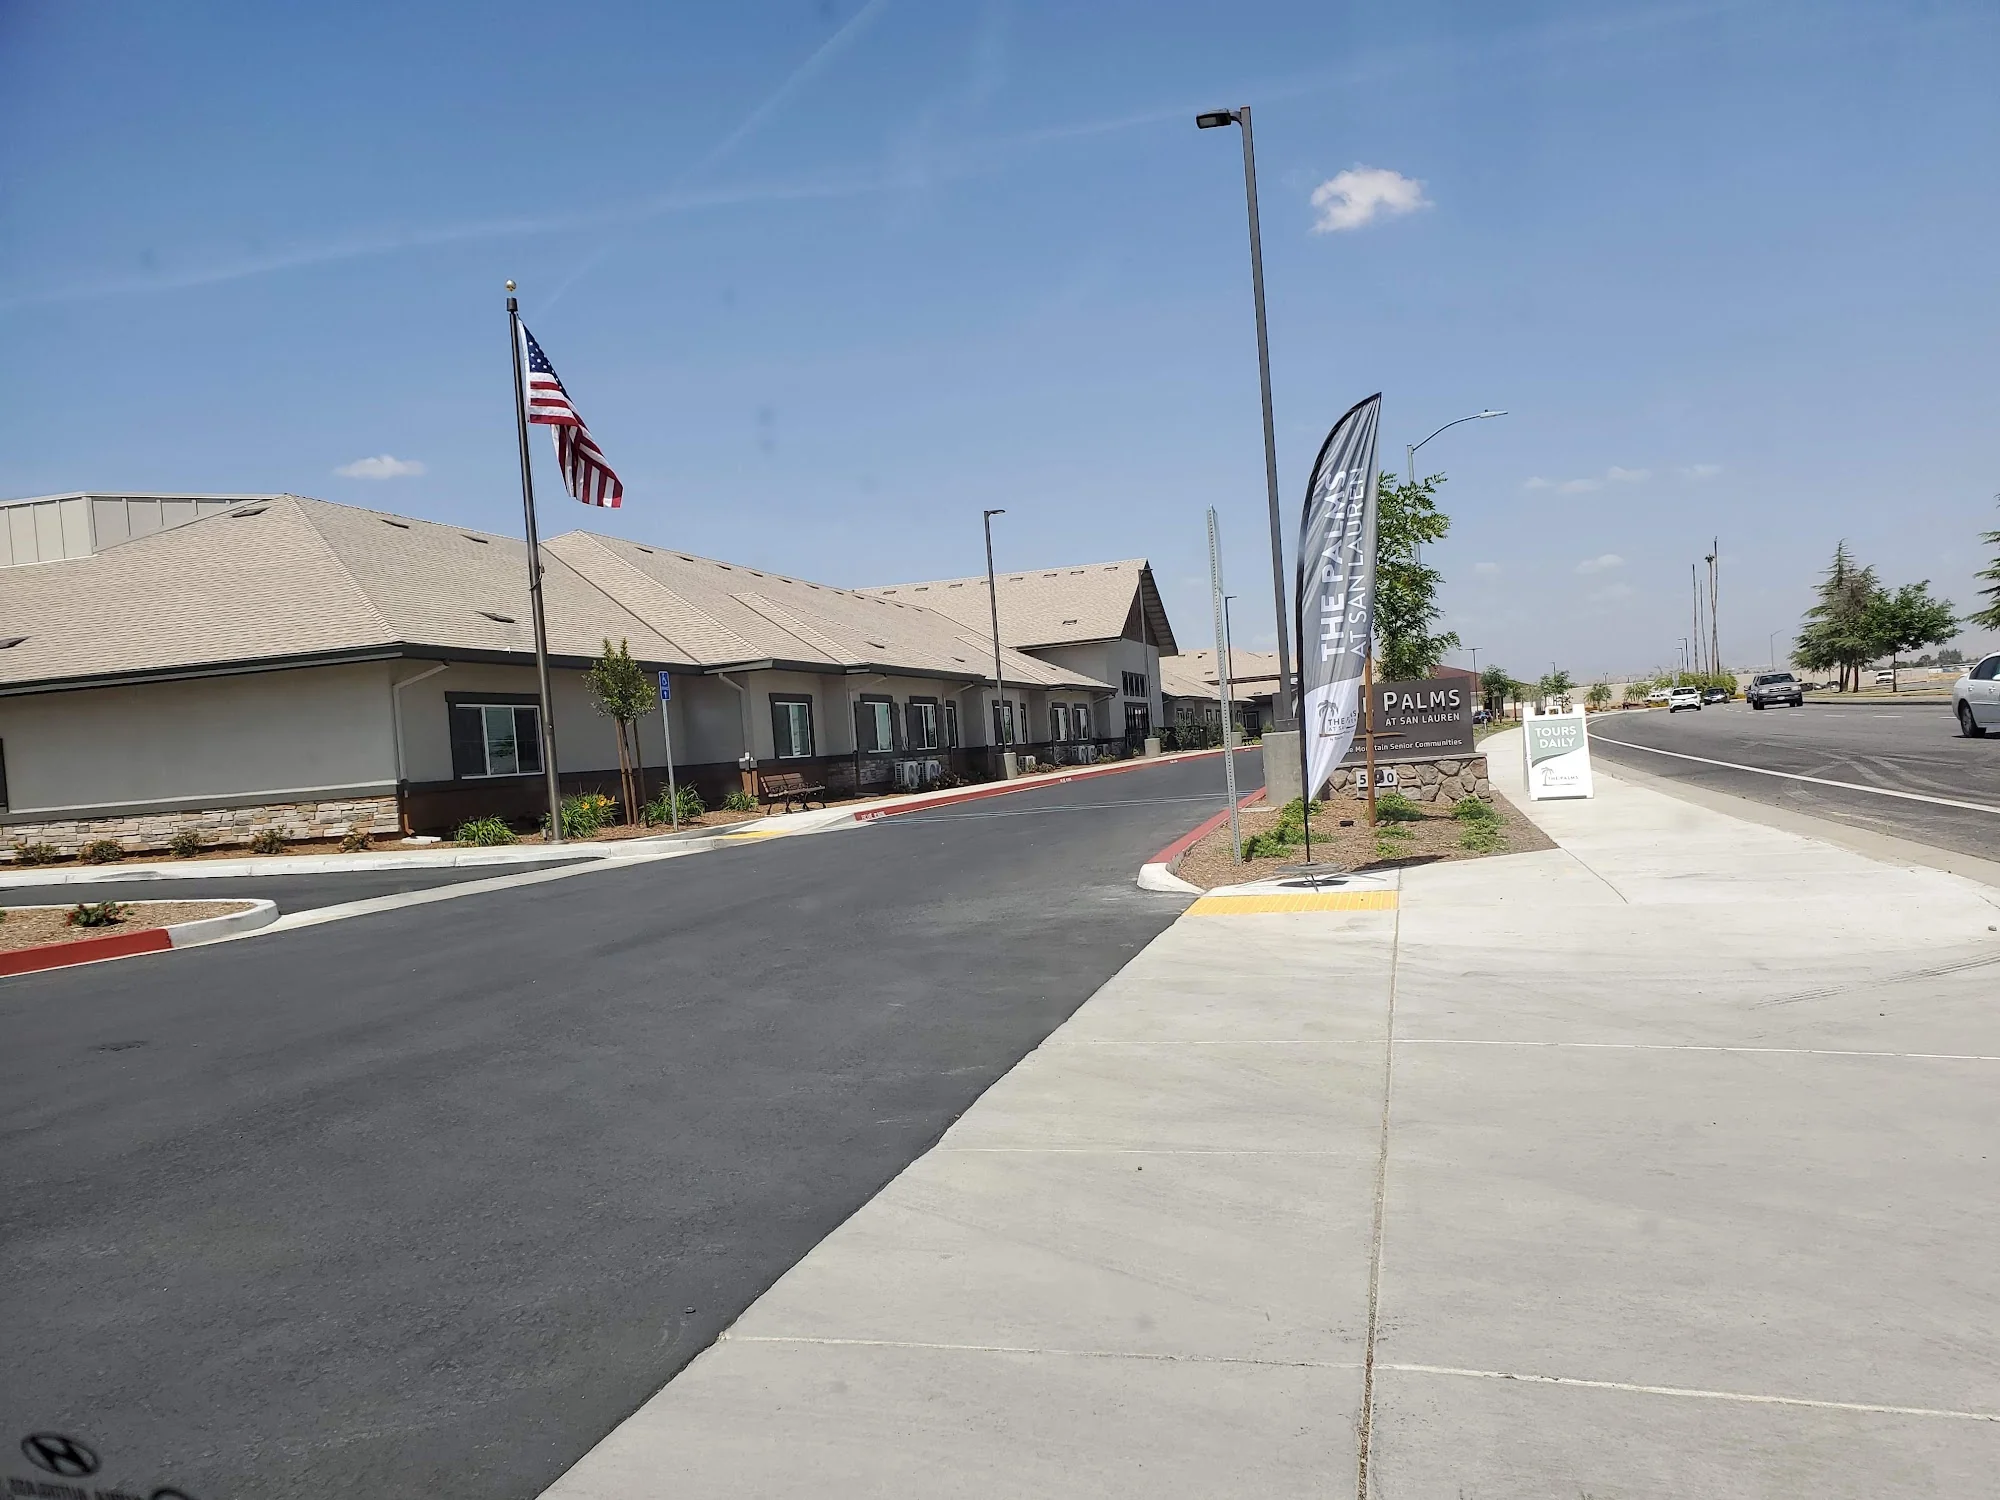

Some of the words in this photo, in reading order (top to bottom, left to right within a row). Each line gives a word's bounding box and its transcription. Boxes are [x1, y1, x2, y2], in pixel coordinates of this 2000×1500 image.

[1321, 470, 1347, 583] PALMS
[1347, 467, 1364, 567] LAUREN
[1348, 575, 1367, 623] SAN
[1320, 592, 1346, 662] THE
[1349, 631, 1367, 658] AT
[1383, 689, 1460, 712] PALMS
[1328, 717, 1345, 726] THE
[1385, 717, 1397, 727] AT
[1400, 715, 1419, 725] SAN
[1422, 713, 1460, 724] LAUREN
[1534, 726, 1577, 738] TOURS
[1540, 737, 1575, 749] DAILY
[1390, 742, 1413, 751] Senior
[1415, 739, 1462, 748] Communities
